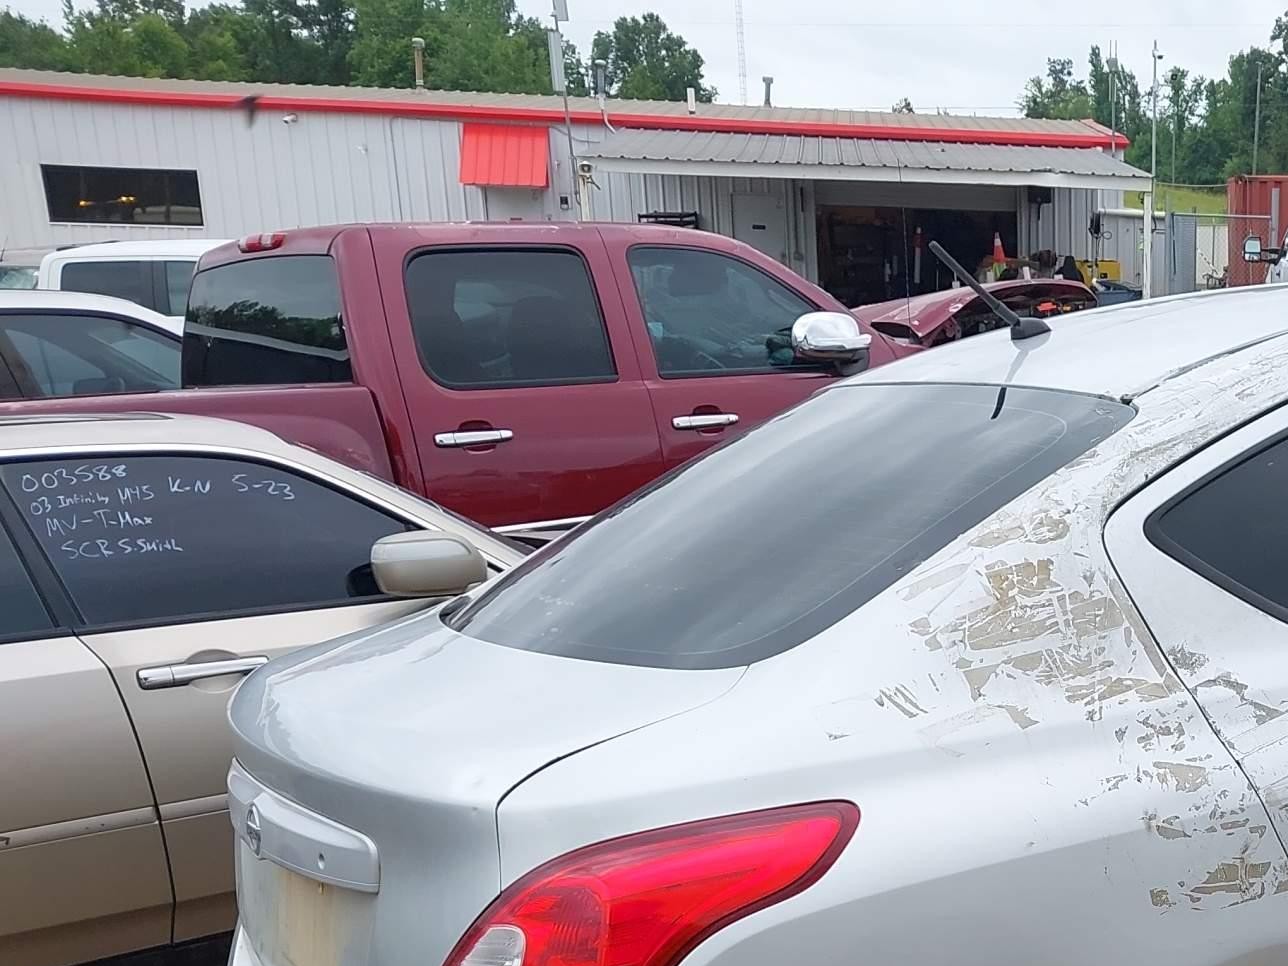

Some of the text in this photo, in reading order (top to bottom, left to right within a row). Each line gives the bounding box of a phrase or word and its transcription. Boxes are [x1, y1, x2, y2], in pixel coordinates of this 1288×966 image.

[21, 464, 128, 492] 003588
[30, 496, 51, 515] 03
[117, 485, 155, 504] M45
[61, 540, 114, 559] SCR
